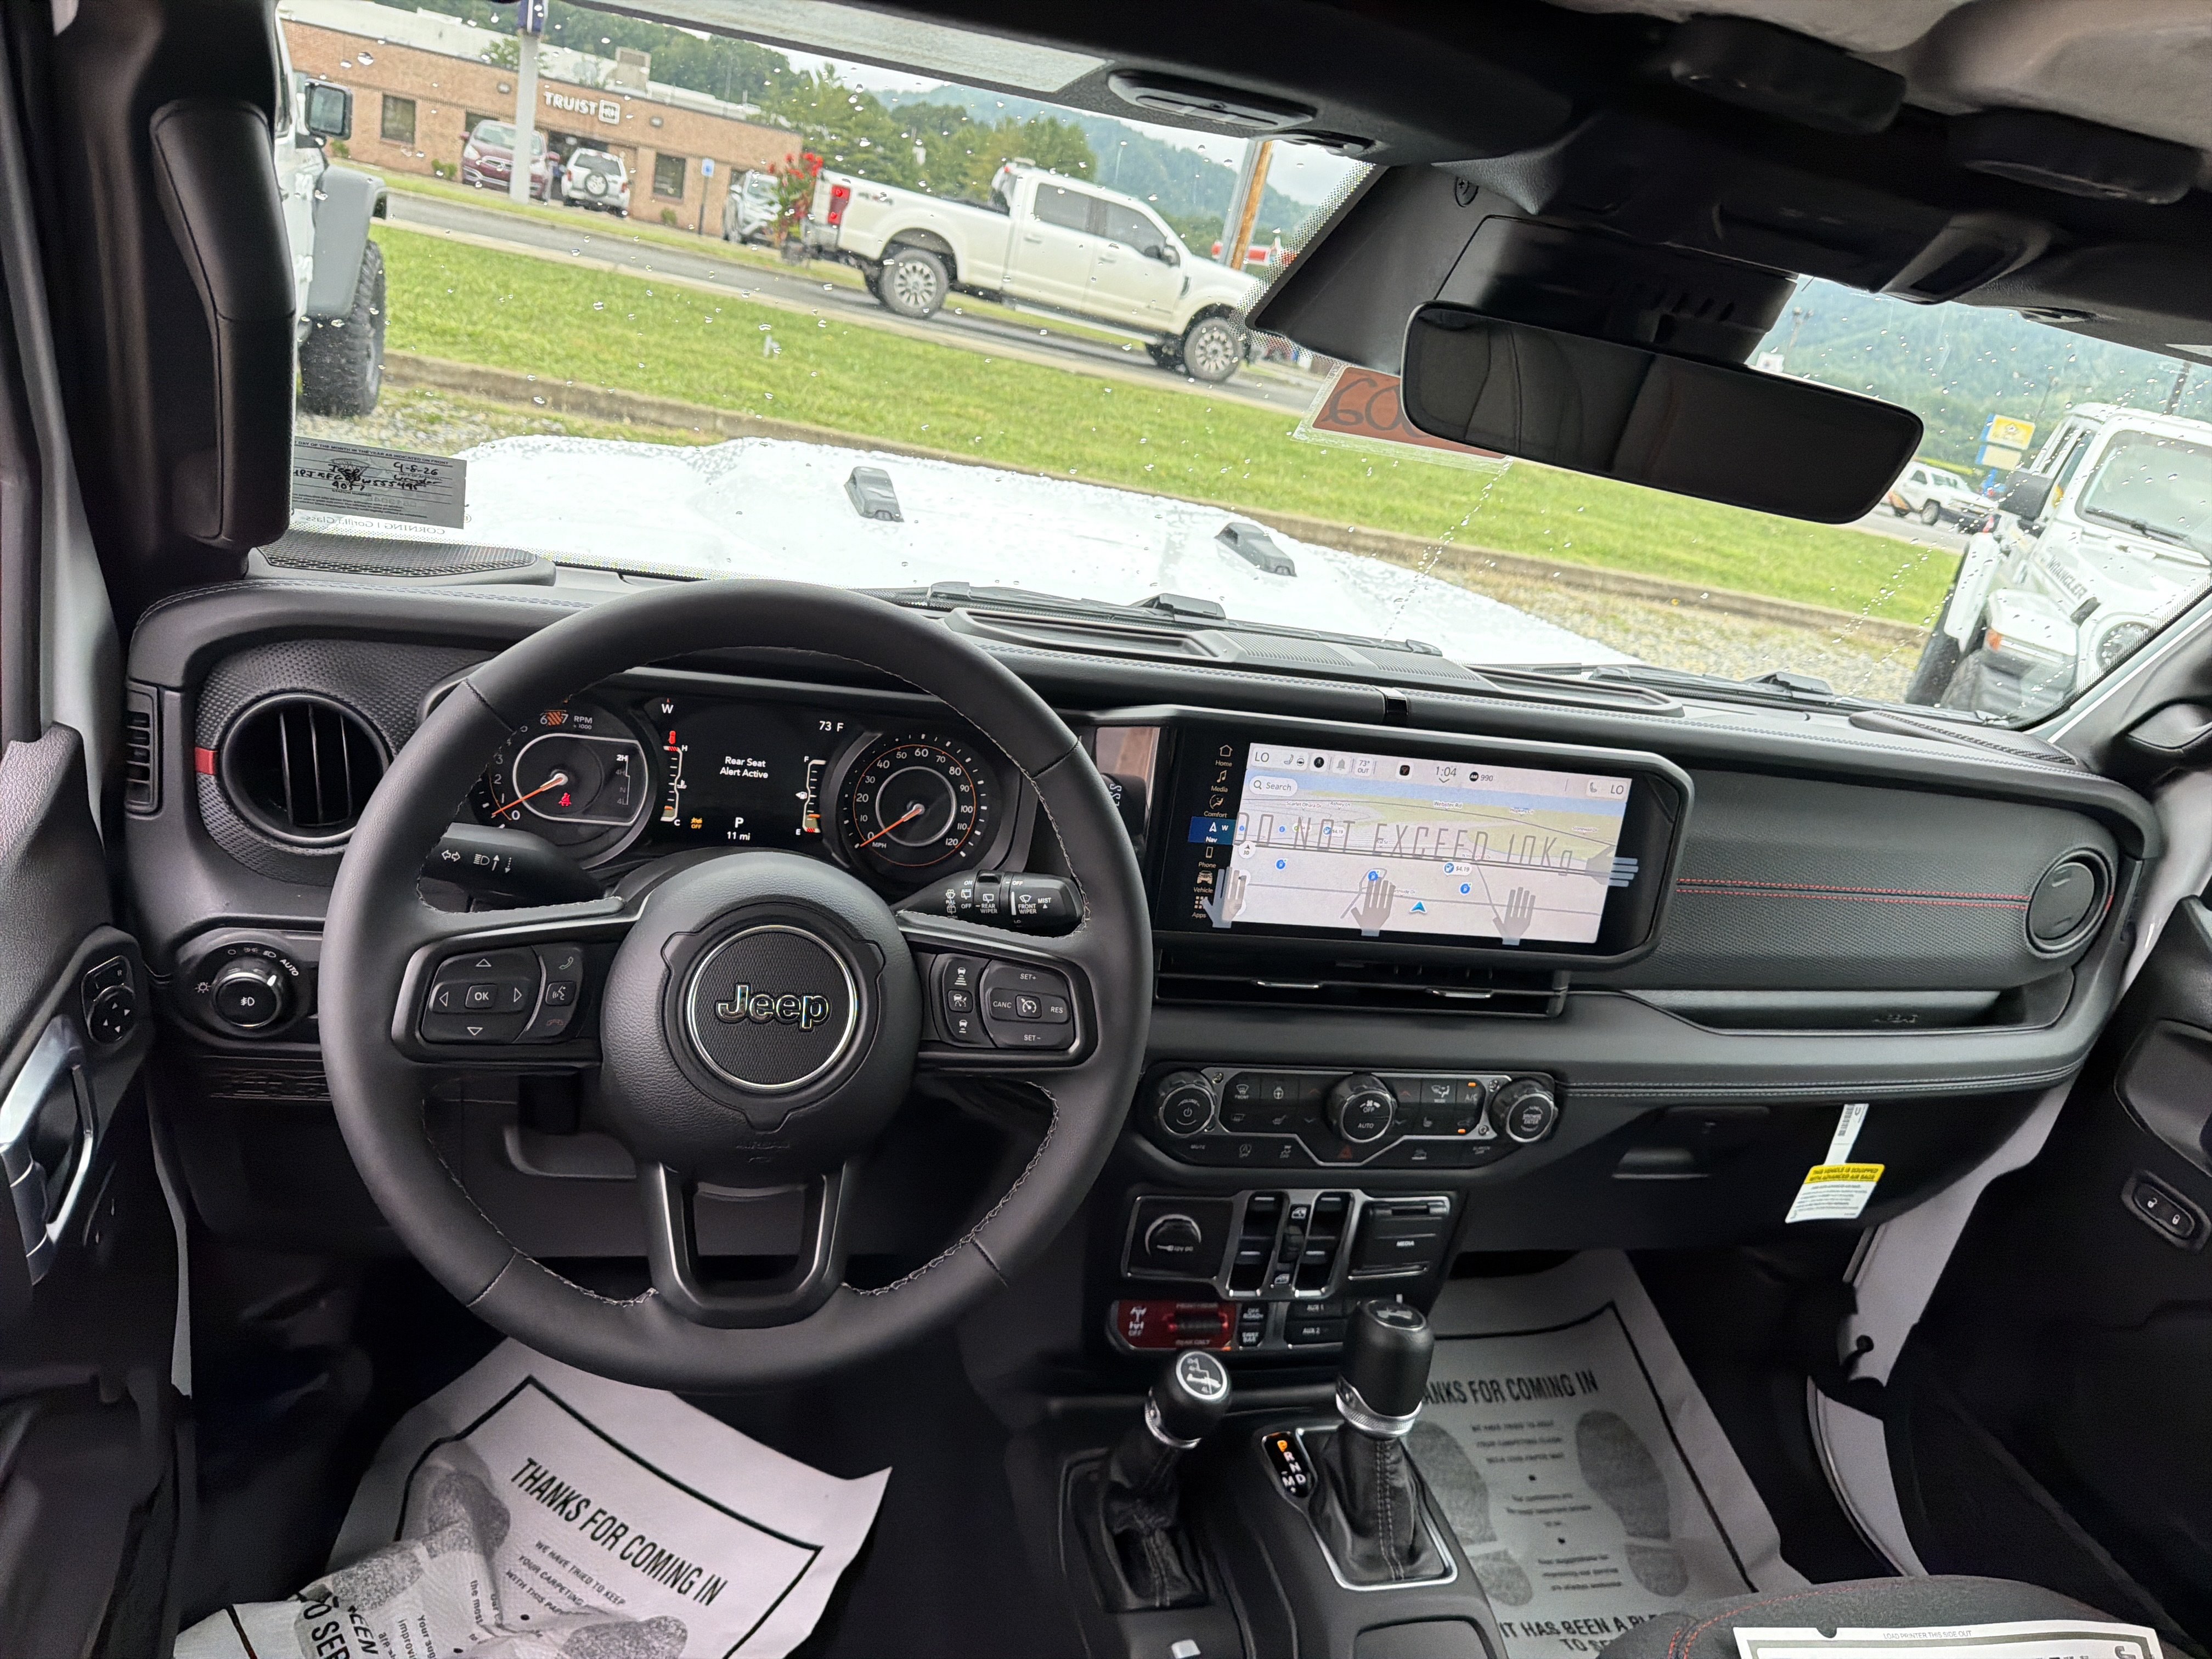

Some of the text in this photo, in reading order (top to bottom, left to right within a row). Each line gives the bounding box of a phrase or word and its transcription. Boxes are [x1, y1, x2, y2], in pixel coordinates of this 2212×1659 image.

[543, 91, 598, 115] TRUIST
[662, 704, 674, 714] W
[540, 715, 548, 725] 6
[574, 715, 592, 724] RPM
[819, 721, 844, 732] 73 F
[915, 749, 928, 757] 60
[1255, 752, 1269, 763] LO
[496, 755, 503, 764] 3
[725, 757, 766, 768] Rear Seat
[877, 760, 890, 769] 40
[936, 755, 946, 763] 70
[720, 768, 768, 778] Alert Active
[949, 767, 961, 775] 80
[1436, 766, 1457, 777] 1:04
[494, 775, 501, 785] 2
[1266, 782, 1291, 791] Search
[1611, 785, 1624, 794] LO
[856, 794, 869, 803] 20
[511, 810, 520, 821] 0
[735, 817, 744, 828] P
[739, 832, 751, 840] mi
[1234, 812, 1274, 848] DO
[1294, 816, 1356, 853] NOT
[1373, 823, 1488, 863] EXCEED
[280, 958, 299, 977] AUTO
[475, 992, 489, 1002] OK
[715, 983, 831, 1031] Jeep
[1468, 1369, 1600, 1403] FOR COMING IN
[1284, 1452, 1295, 1462] R
[1289, 1462, 1302, 1474] N
[1282, 1476, 1295, 1487] M
[1295, 1474, 1306, 1485] D
[509, 1457, 729, 1607] THANKS FOR COMING IN
[535, 1540, 626, 1605] WE HAVE TRIED TO KEEP
[518, 1555, 584, 1606] YOUR CARPETING
[506, 1569, 546, 1604] WITH THIS
[470, 1579, 483, 1624] the most
[417, 1615, 430, 1638] Your
[1498, 1622, 1516, 1638] IT
[1520, 1620, 1561, 1637] HAS
[1561, 1618, 1611, 1635] BEEN
[1613, 1617, 1628, 1632] A
[1560, 1638, 1588, 1651] TO
